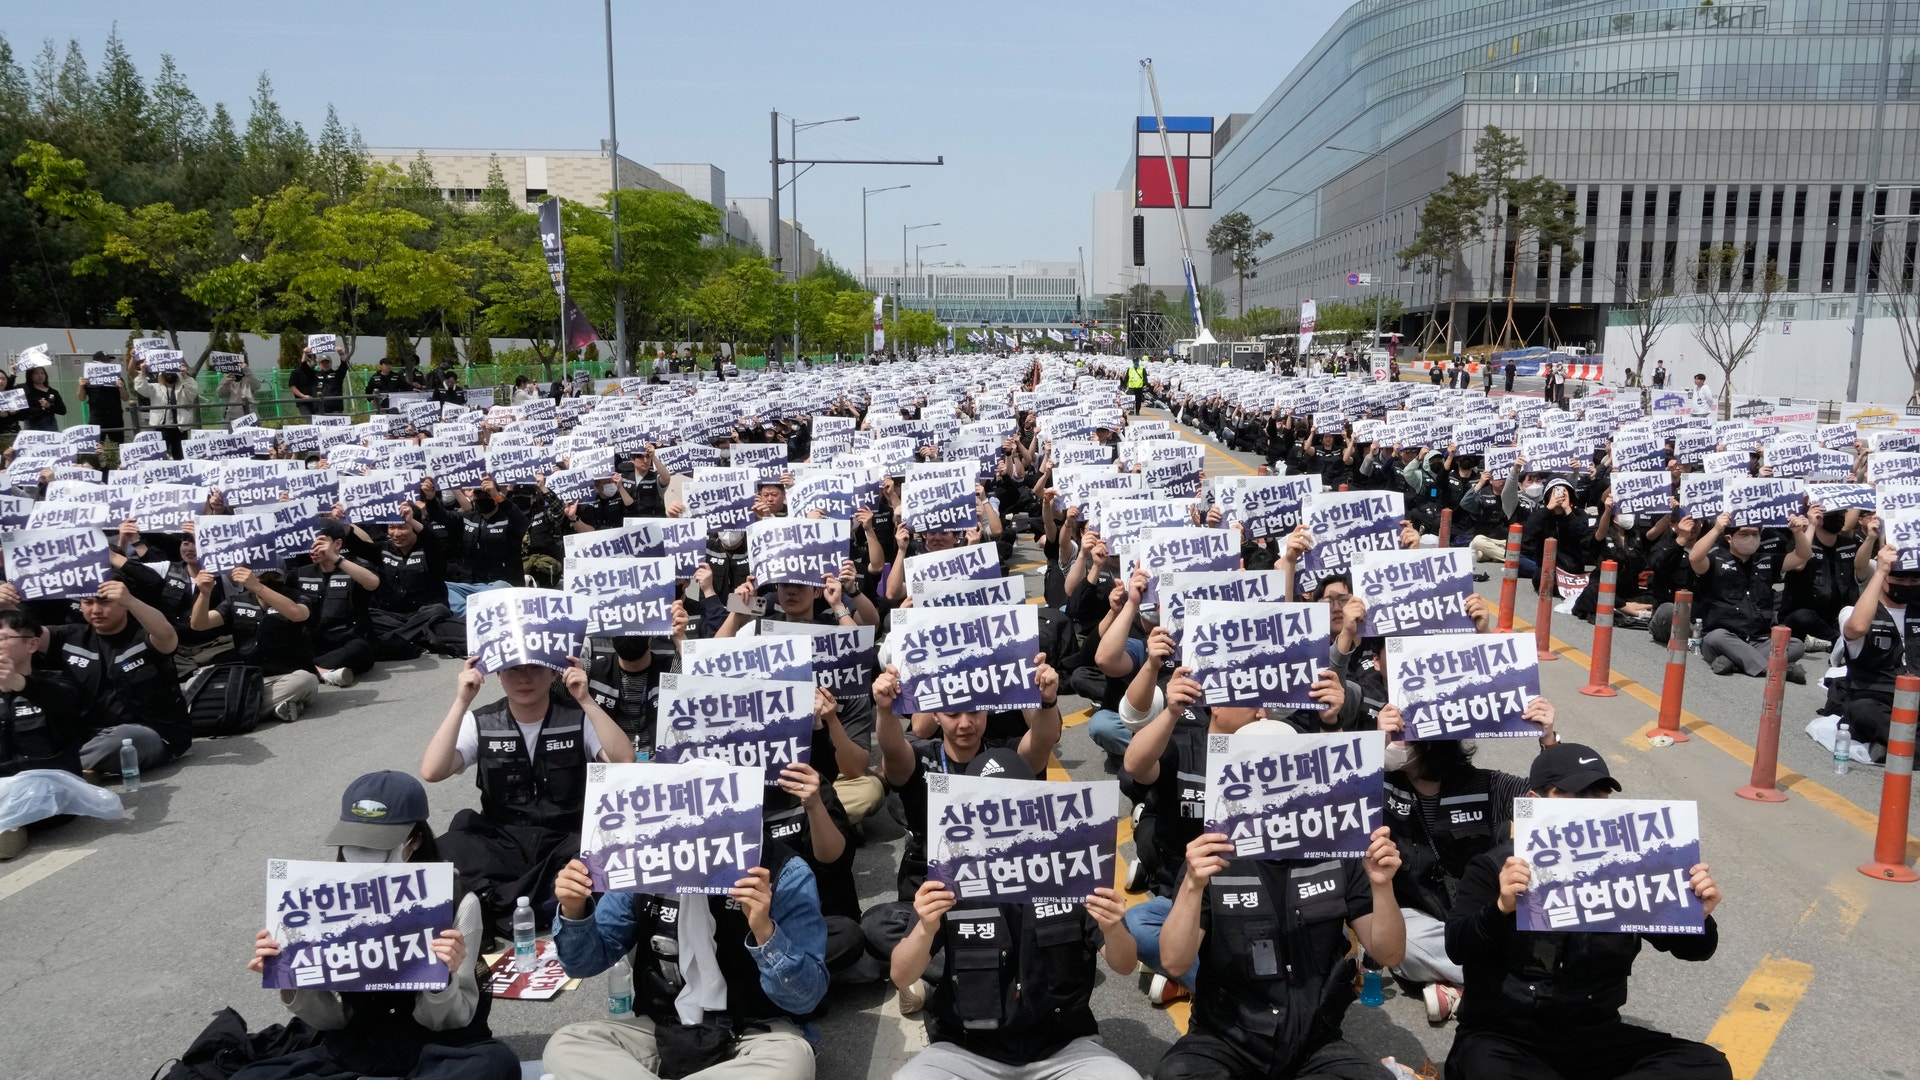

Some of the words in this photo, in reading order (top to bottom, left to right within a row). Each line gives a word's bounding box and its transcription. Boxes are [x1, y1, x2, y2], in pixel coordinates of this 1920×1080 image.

[310, 335, 332, 345] 상한폐지
[148, 351, 178, 362] 상한폐지
[212, 354, 240, 364] 상한폐지
[86, 366, 117, 374] 상한폐지
[150, 361, 181, 372] 실현하자
[89, 375, 118, 386] 실현하자
[409, 402, 436, 416] 상한폐지
[524, 399, 552, 412] 상한폐지
[1294, 395, 1317, 405] 상한폐지
[1515, 398, 1541, 410] 상한폐지
[414, 414, 440, 428] 실현하자
[816, 420, 850, 432] 상한폐지
[1316, 413, 1341, 423] 상한폐지
[1652, 416, 1683, 428] 상한폐지
[62, 428, 94, 444] 상한폐지
[286, 427, 320, 440] 상한폐지
[523, 421, 554, 434] 상한폐지
[610, 424, 644, 438] 상한폐지
[880, 422, 917, 438] 상한폐지
[1050, 421, 1086, 434] 상한폐지
[1317, 423, 1344, 434] 실현하자
[1398, 422, 1428, 436] 상한폐지
[1455, 427, 1491, 441] 상한폐지
[1576, 424, 1606, 437] 상한폐지
[1820, 425, 1852, 438] 상한폐지
[18, 434, 56, 446] 상한폐지
[208, 436, 247, 451] 상한폐지
[1458, 442, 1493, 454] 실현하자
[1527, 440, 1568, 455] 상한폐지
[1678, 436, 1714, 450] 상한폐지
[1826, 436, 1856, 448] 실현하자
[1879, 436, 1916, 450] 상한폐지
[122, 444, 160, 462] 상한폐지
[490, 449, 534, 467] 상한폐지
[572, 450, 608, 467] 상한폐지
[734, 446, 780, 464] 상한폐지
[812, 444, 846, 458] 상한폐지
[946, 444, 990, 461] 상한폐지
[1062, 448, 1106, 462] 상한폐지
[1152, 446, 1198, 460] 상한폐지
[1615, 440, 1658, 459] 상한폐지
[1767, 443, 1813, 462] 상한폐지
[430, 448, 477, 470] 상한폐지
[1531, 456, 1572, 472] 실현하자
[1708, 453, 1745, 469] 상한폐지
[142, 462, 194, 484] 상한폐지
[223, 464, 278, 484] 상한폐지
[494, 466, 539, 484] 실현하자
[1146, 462, 1193, 484] 상한폐지
[1773, 461, 1819, 478] 실현하자
[437, 468, 486, 490] 실현하자
[546, 472, 588, 490] 상한폐지
[1615, 474, 1664, 494] 상한폐지
[226, 487, 283, 506] 실현하자
[342, 478, 396, 500] 상한폐지
[686, 484, 745, 510] 상한폐지
[791, 478, 844, 506] 상한폐지
[905, 478, 966, 508] 상한폐지
[1243, 478, 1312, 510] 상한폐지
[1728, 480, 1784, 504] 상한폐지
[134, 488, 197, 509] 상한폐지
[1620, 494, 1670, 514] 실현하자
[1822, 492, 1876, 509] 실현하자
[32, 507, 96, 528] 상한폐지
[136, 510, 196, 531] 실현하자
[350, 501, 402, 523] 실현하자
[912, 504, 976, 532] 실현하자
[1108, 504, 1174, 528] 상한폐지
[1310, 494, 1393, 534] 상한폐지
[1734, 504, 1790, 526] 실현하자
[198, 516, 263, 548] 상한폐지
[1250, 510, 1302, 538] 실현하
[752, 524, 821, 556] 상한폐지
[1320, 528, 1402, 568] 실현하자
[12, 531, 96, 568] 상한폐지
[202, 544, 275, 573] 실현하자
[1148, 534, 1228, 568] 상한폐지
[756, 554, 832, 582] 실현하자
[912, 548, 986, 581] 상한폐지
[21, 562, 110, 598] 실현하자
[570, 562, 661, 596] 상한폐지
[1360, 552, 1458, 596] 상한폐지
[168, 578, 186, 590] 투쟁
[302, 583, 318, 591] 투쟁
[236, 608, 256, 618] 투쟁
[473, 596, 573, 635] 상한폐지
[586, 598, 674, 633] 실현하자
[1372, 591, 1468, 634] 실현하자
[902, 610, 1020, 663] 상한폐지
[1192, 608, 1313, 656] 상한폐지
[482, 632, 581, 672] 실현하자
[692, 639, 796, 678] 상한폐지
[68, 656, 90, 668] 투쟁
[122, 658, 145, 672] SELU
[1398, 638, 1518, 692] 상한폐지
[914, 658, 1040, 711] 실현하자
[1201, 658, 1327, 704] 실현하자
[595, 694, 616, 708] 투쟁
[667, 686, 794, 730] 상한폐지
[1412, 686, 1537, 738] 실현하자
[488, 741, 516, 752] 투쟁
[546, 740, 574, 750] SELU
[980, 766, 1004, 778] adidas
[1217, 738, 1363, 800] 상한폐지
[595, 772, 739, 831] 상한폐지
[1388, 797, 1412, 816] 투쟁
[939, 787, 1093, 842] 상한폐지
[1451, 810, 1482, 824] SELU
[770, 823, 801, 838] SELU
[1230, 797, 1384, 857] 실현하자
[1526, 806, 1674, 868] 상한폐지
[604, 832, 759, 890] 실현하자
[954, 845, 1115, 898] 실현하자
[277, 869, 428, 928] 상한폐지
[1298, 881, 1336, 898] SELU
[1543, 868, 1690, 928] 실현하자
[1222, 891, 1258, 908] 투쟁
[1035, 903, 1073, 918] SELU
[957, 922, 996, 940] 투쟁
[290, 928, 438, 987] 실현하자
